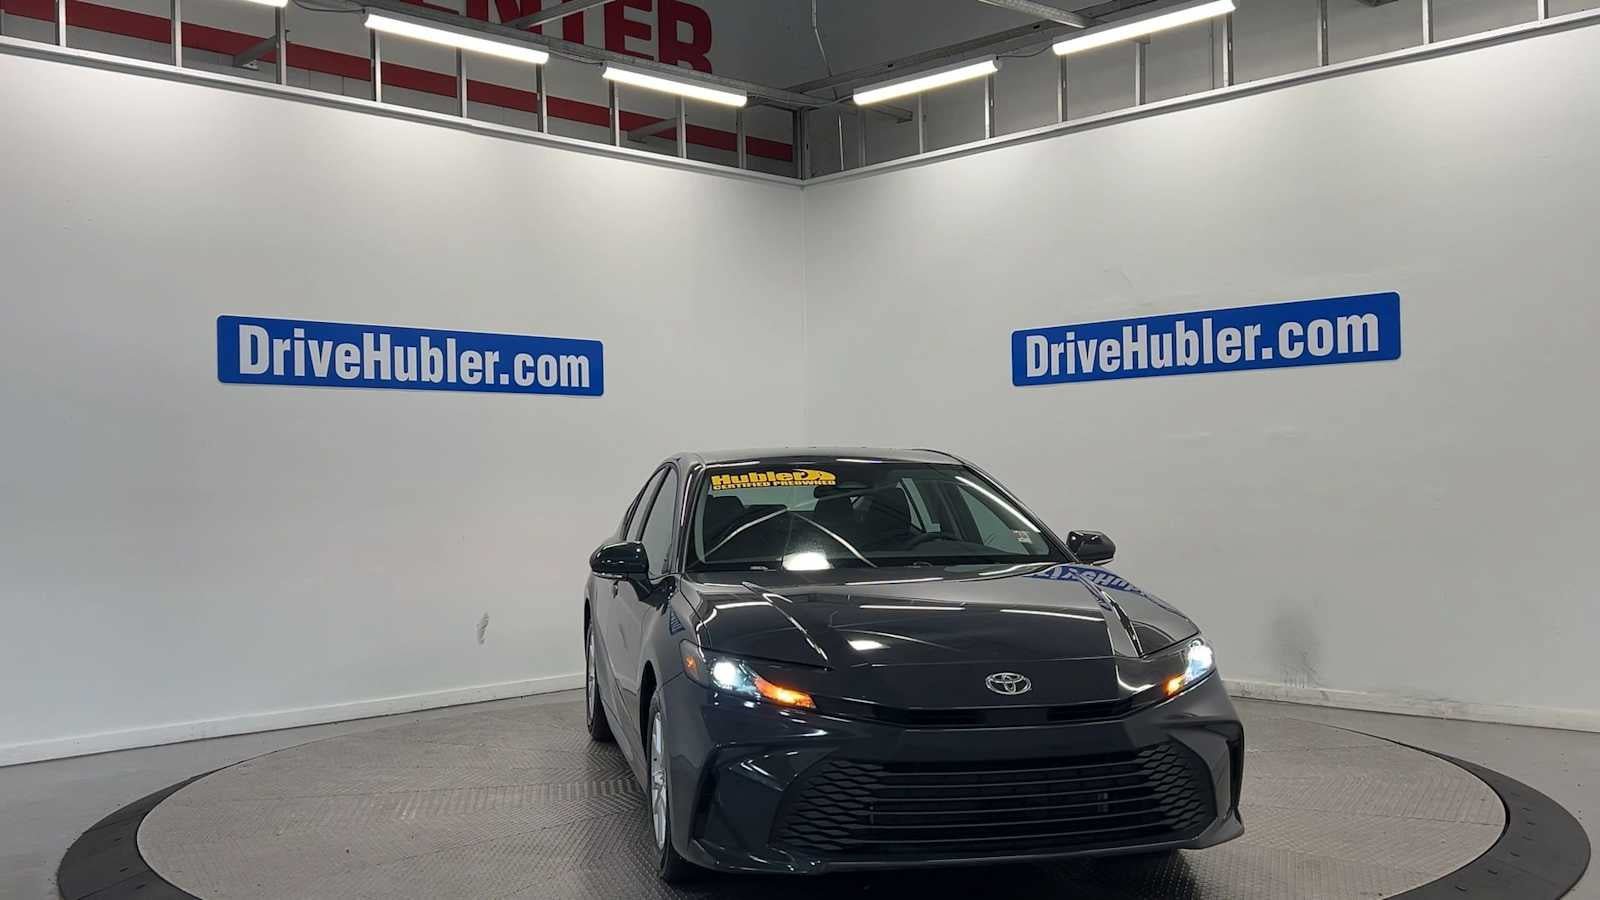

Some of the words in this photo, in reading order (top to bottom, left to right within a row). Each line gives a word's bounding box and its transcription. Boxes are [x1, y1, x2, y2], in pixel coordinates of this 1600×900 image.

[239, 323, 591, 389] DriveHubler.com
[1026, 312, 1380, 378] DriveHubler.com
[711, 470, 814, 485] Hubler
[713, 481, 771, 490] CERTIFIED
